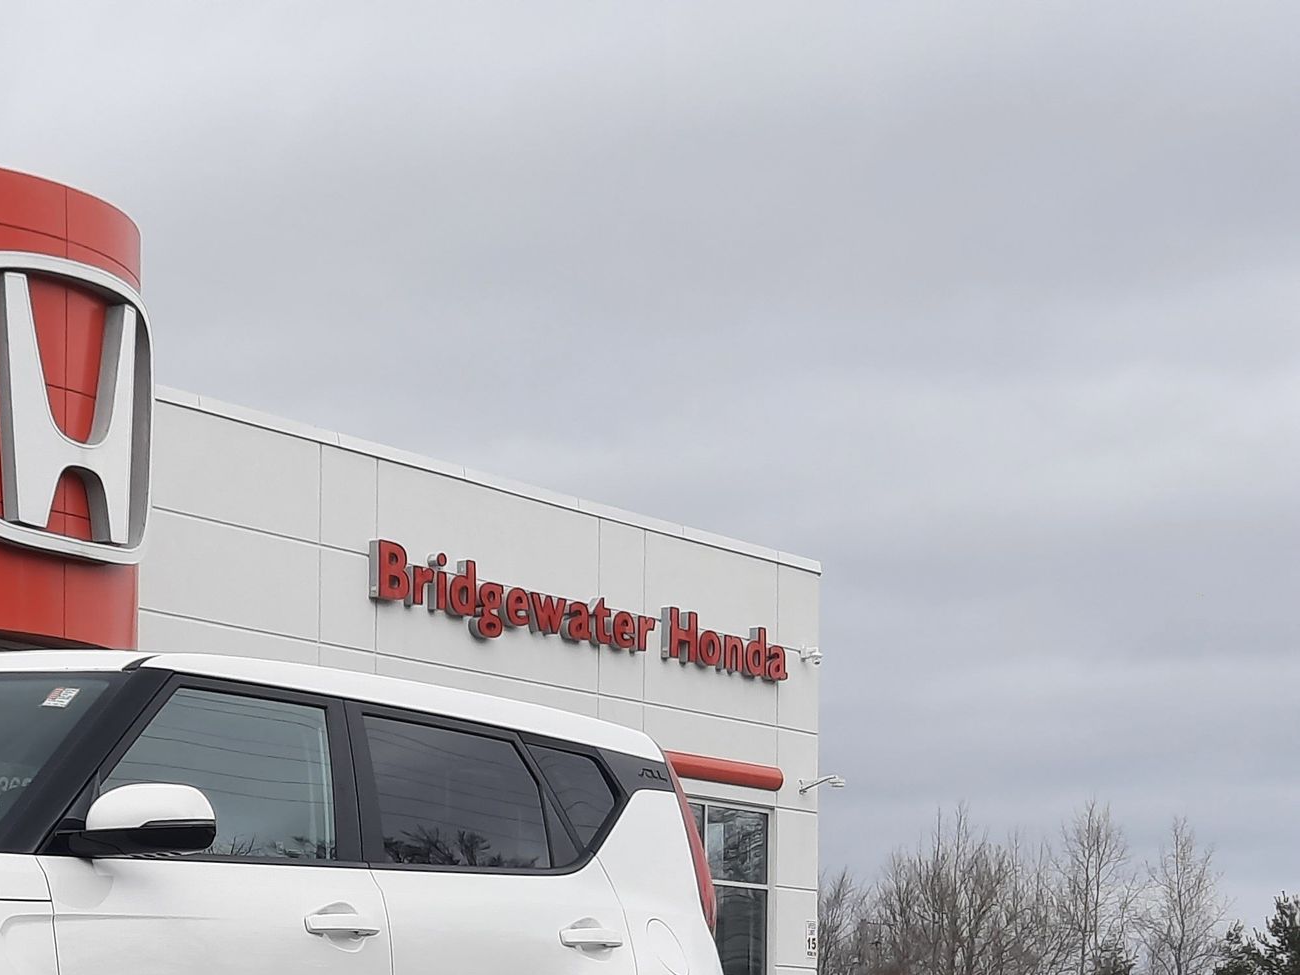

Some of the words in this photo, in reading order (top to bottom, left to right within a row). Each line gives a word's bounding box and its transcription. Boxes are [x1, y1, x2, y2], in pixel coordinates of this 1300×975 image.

[369, 538, 656, 640] Bridgewater
[661, 606, 789, 681] Honda
[807, 937, 817, 950] 15
